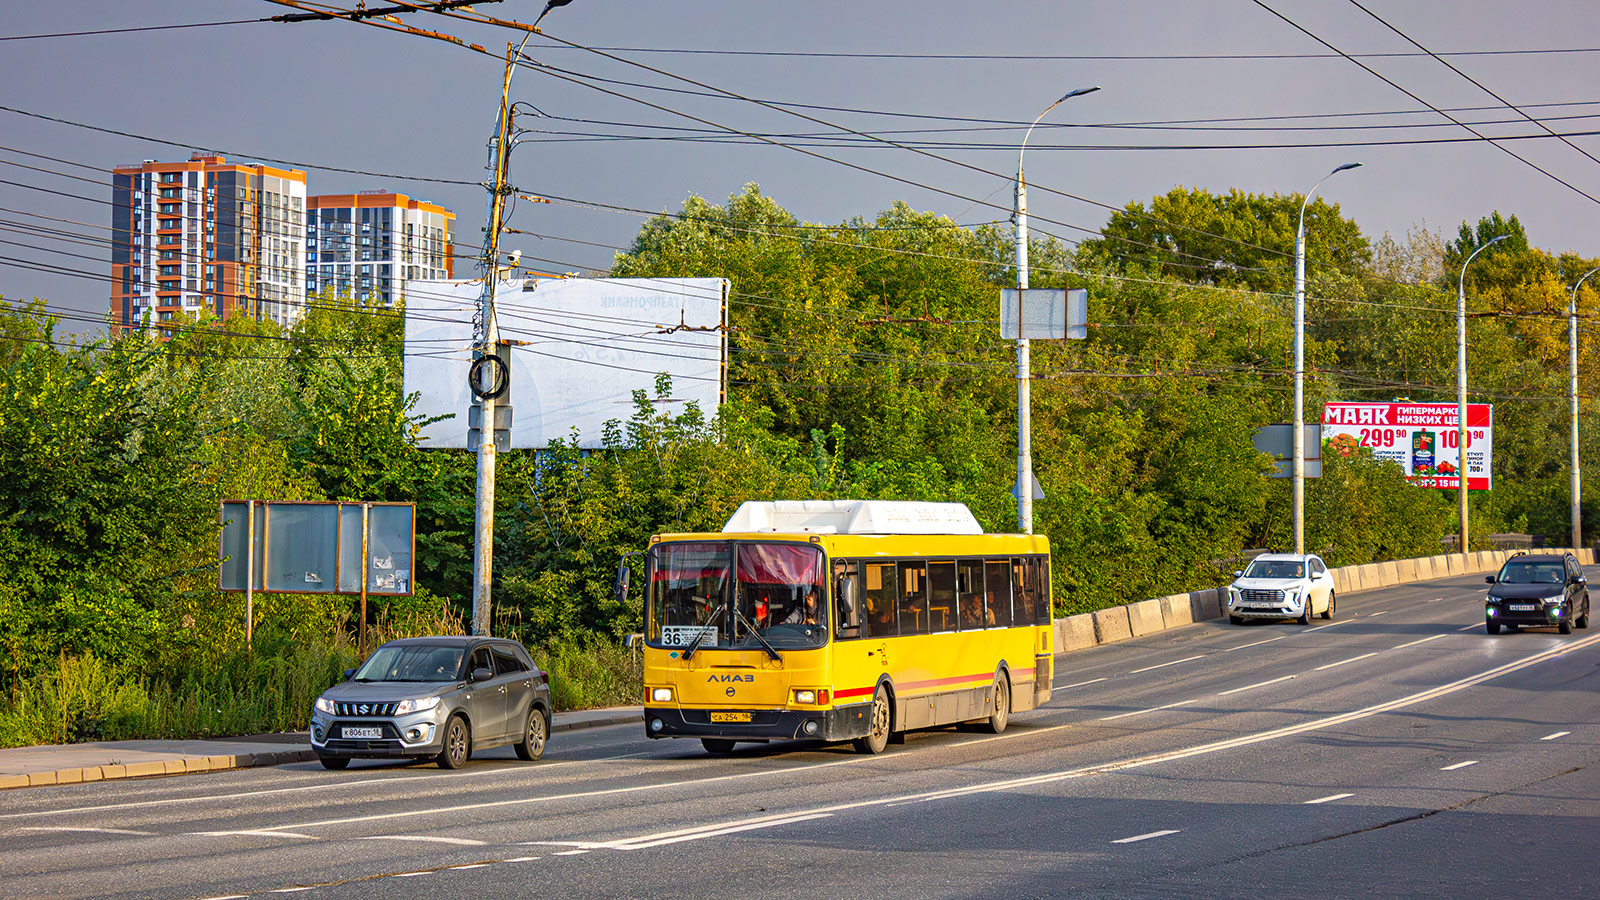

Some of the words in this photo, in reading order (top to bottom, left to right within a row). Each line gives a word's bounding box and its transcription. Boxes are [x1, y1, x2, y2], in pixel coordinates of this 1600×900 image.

[1325, 406, 1389, 424] МАЯК
[1397, 407, 1459, 415] ГИПЕРМАРКЕ
[1397, 415, 1442, 424] НИЗКИХ
[1444, 416, 1459, 426] ЦЕ
[1360, 428, 1394, 447] 299
[1396, 429, 1407, 438] 90
[1473, 430, 1484, 439] 90
[664, 633, 681, 645] 36
[724, 713, 738, 721] 254
